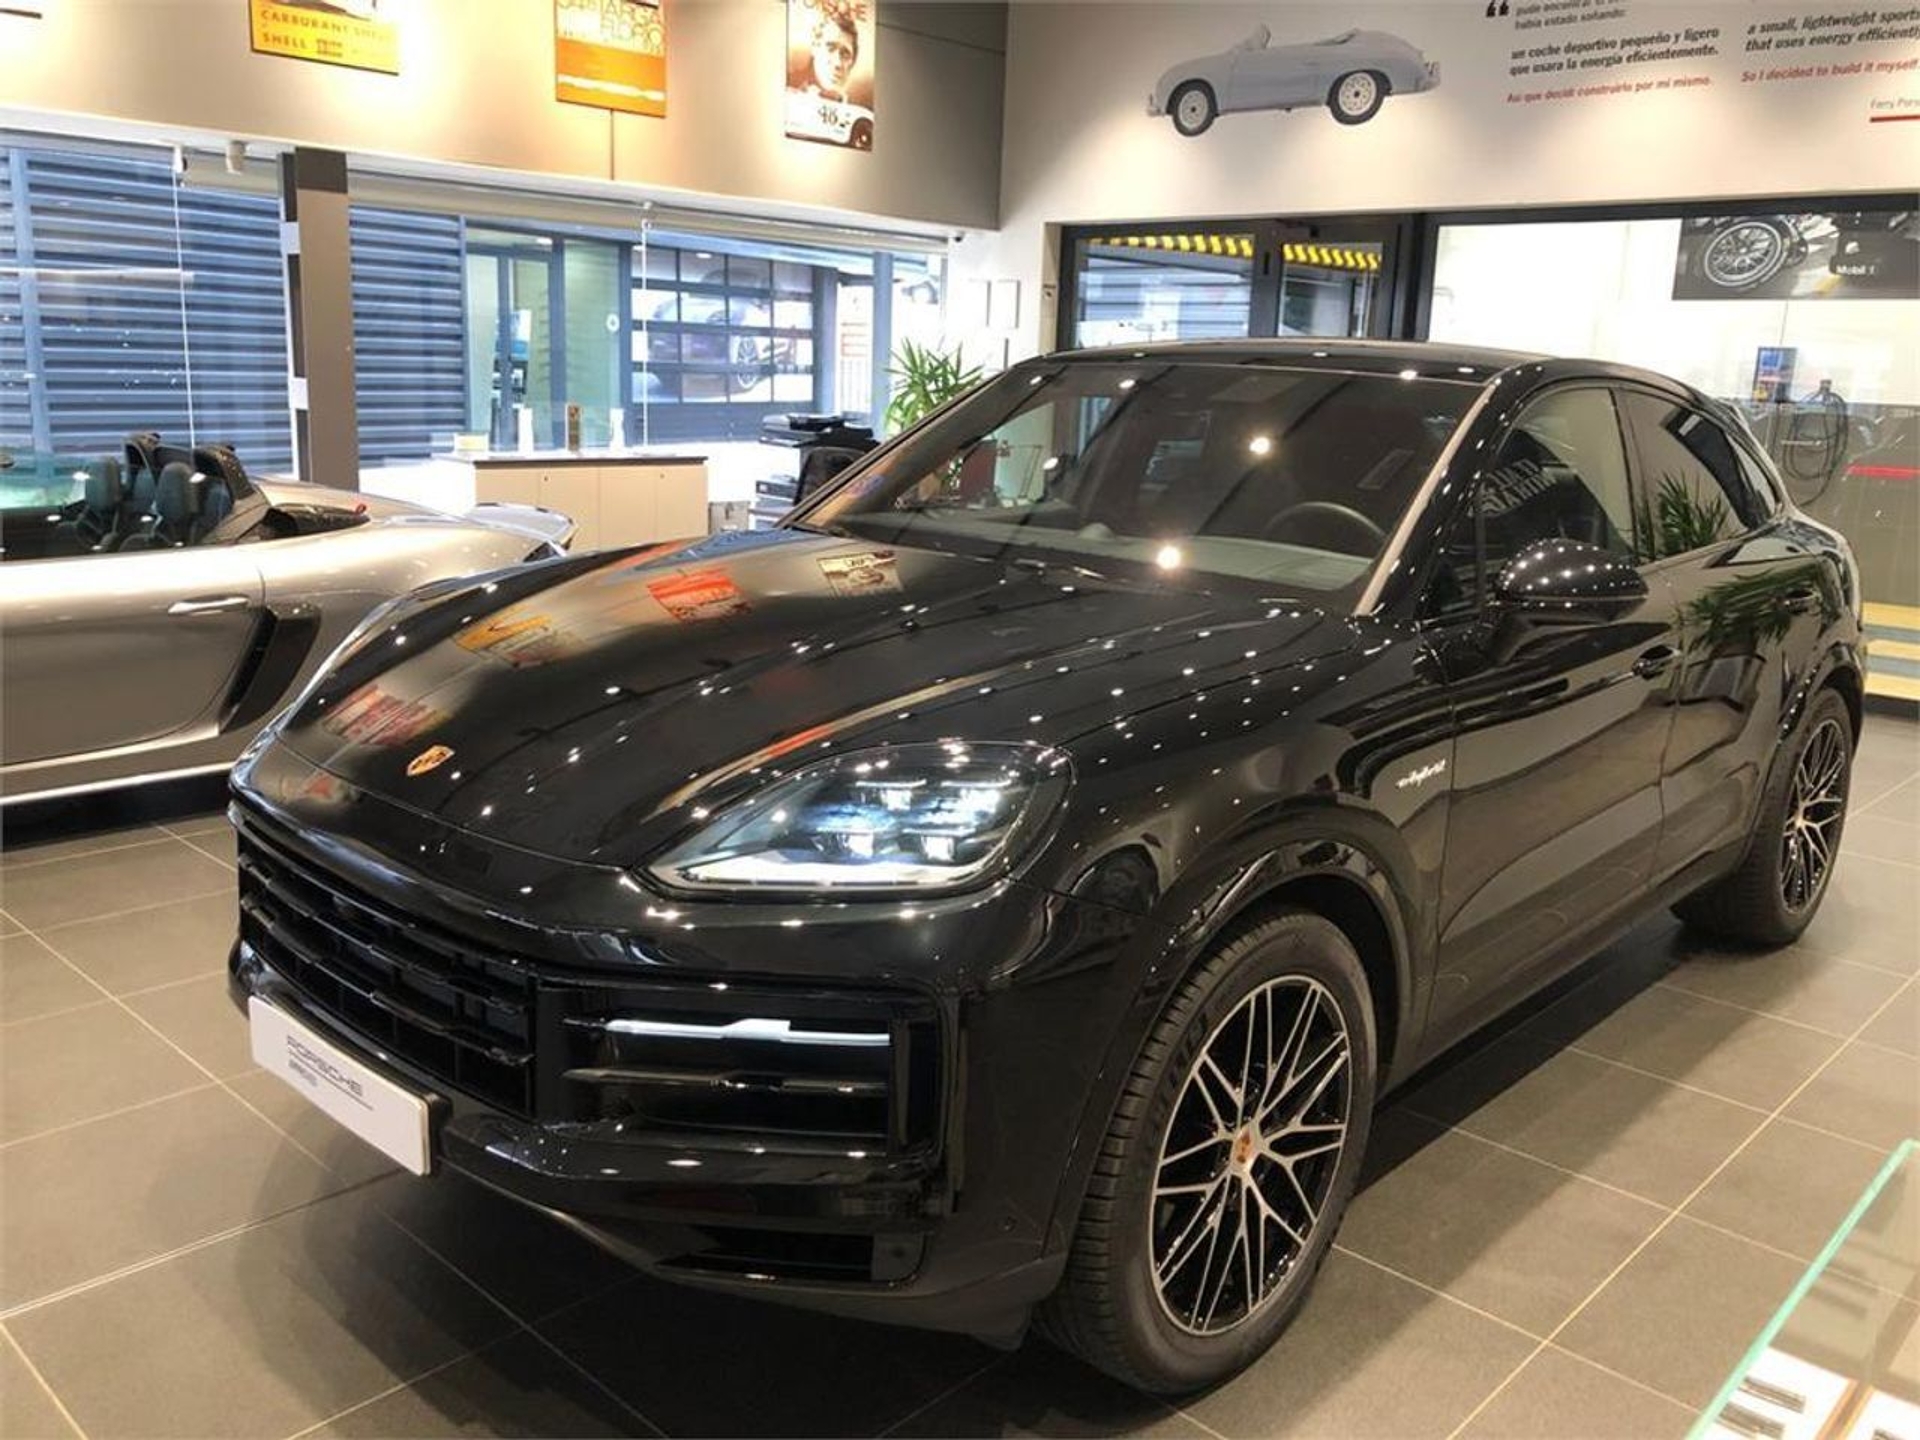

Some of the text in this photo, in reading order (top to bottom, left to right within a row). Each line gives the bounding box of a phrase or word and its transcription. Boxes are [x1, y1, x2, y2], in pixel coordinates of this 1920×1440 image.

[260, 9, 349, 34] CARBURANT
[1747, 25, 1756, 35] a
[1802, 11, 1877, 31] lightweight
[262, 32, 308, 50] SHELL
[1511, 27, 1719, 59] un coche deportivo pequeño y ligero
[1746, 37, 1773, 52] that
[1775, 38, 1805, 50] uses
[1808, 33, 1853, 48] energy
[1509, 64, 1530, 77] que
[1532, 61, 1564, 74] usara
[1566, 57, 1578, 69] la
[1625, 44, 1719, 63] eficientemente.
[1741, 70, 1757, 82] So
[1766, 65, 1813, 80] decided
[1817, 65, 1829, 77] to
[1831, 61, 1862, 76] build
[1864, 60, 1874, 73] it
[1524, 92, 1542, 104] que
[1634, 81, 1653, 93] por
[1836, 264, 1866, 275] Mobil
[286, 1034, 364, 1098] PORSCHE
